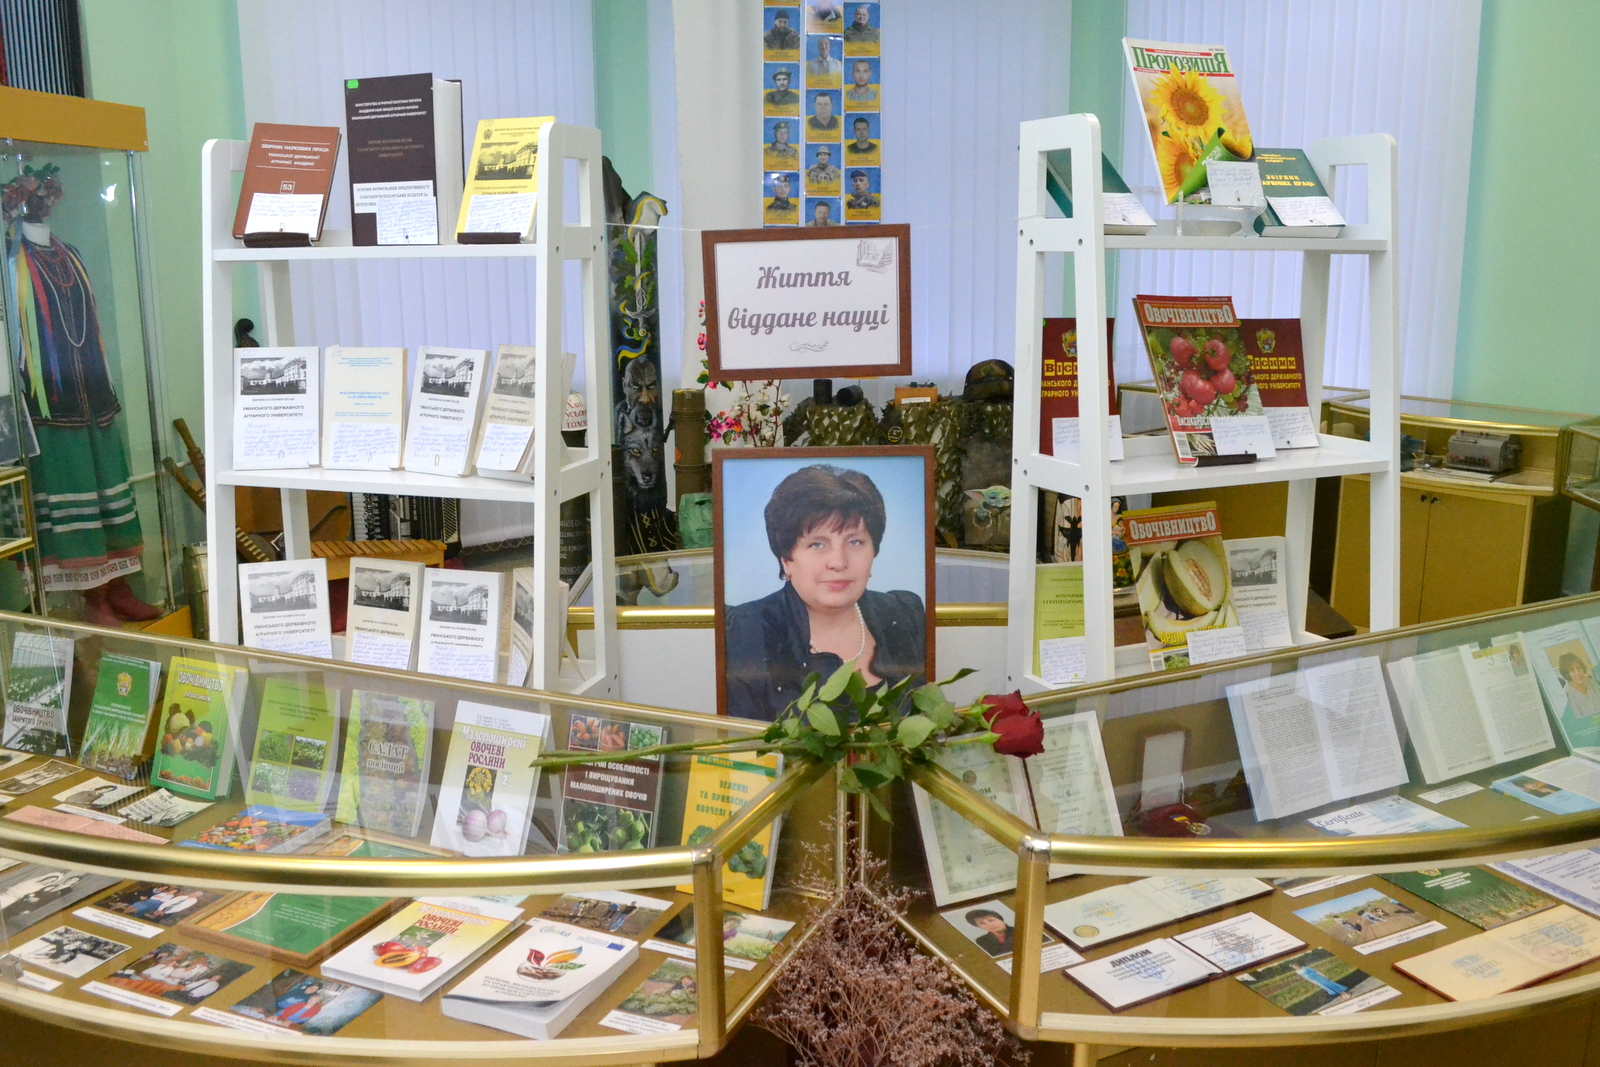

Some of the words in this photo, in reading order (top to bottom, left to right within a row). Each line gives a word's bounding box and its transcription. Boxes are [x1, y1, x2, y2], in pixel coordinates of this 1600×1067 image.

[282, 183, 293, 191] 53
[756, 266, 852, 289] Життя
[728, 307, 818, 336] віддане
[822, 304, 890, 332] науці
[1144, 303, 1234, 324] ОВОЧІВНИЦТВО
[1129, 512, 1216, 540] ОВОЧІВНИЦТВО
[285, 620, 316, 628] ДЕРЖАВНОГО
[178, 671, 223, 692] ОВОЧІВНИЦТВО
[12, 704, 55, 719] ОВОЧІВНИЦТВО
[461, 725, 527, 749] Малопоширені
[470, 741, 505, 757] ОВОЧЕВІ
[468, 752, 506, 769] РОСЛИНИ
[608, 762, 650, 775] ОСОБЛИВОСТІ
[501, 775, 508, 786] 2
[589, 772, 634, 786] ВИРОЩУВАННЯ
[570, 781, 624, 797] МАЛОПОШИРЕНИХ
[625, 790, 647, 801] ОВОЧІВ
[700, 790, 708, 799] ТА
[696, 804, 726, 816] ОВОЧЕВІ
[1317, 810, 1366, 827] Certificate
[414, 920, 459, 934] РОСЛИНИ
[422, 914, 463, 927] ОВОЧЕВІ
[1109, 949, 1153, 968] ДИПЛОМ
